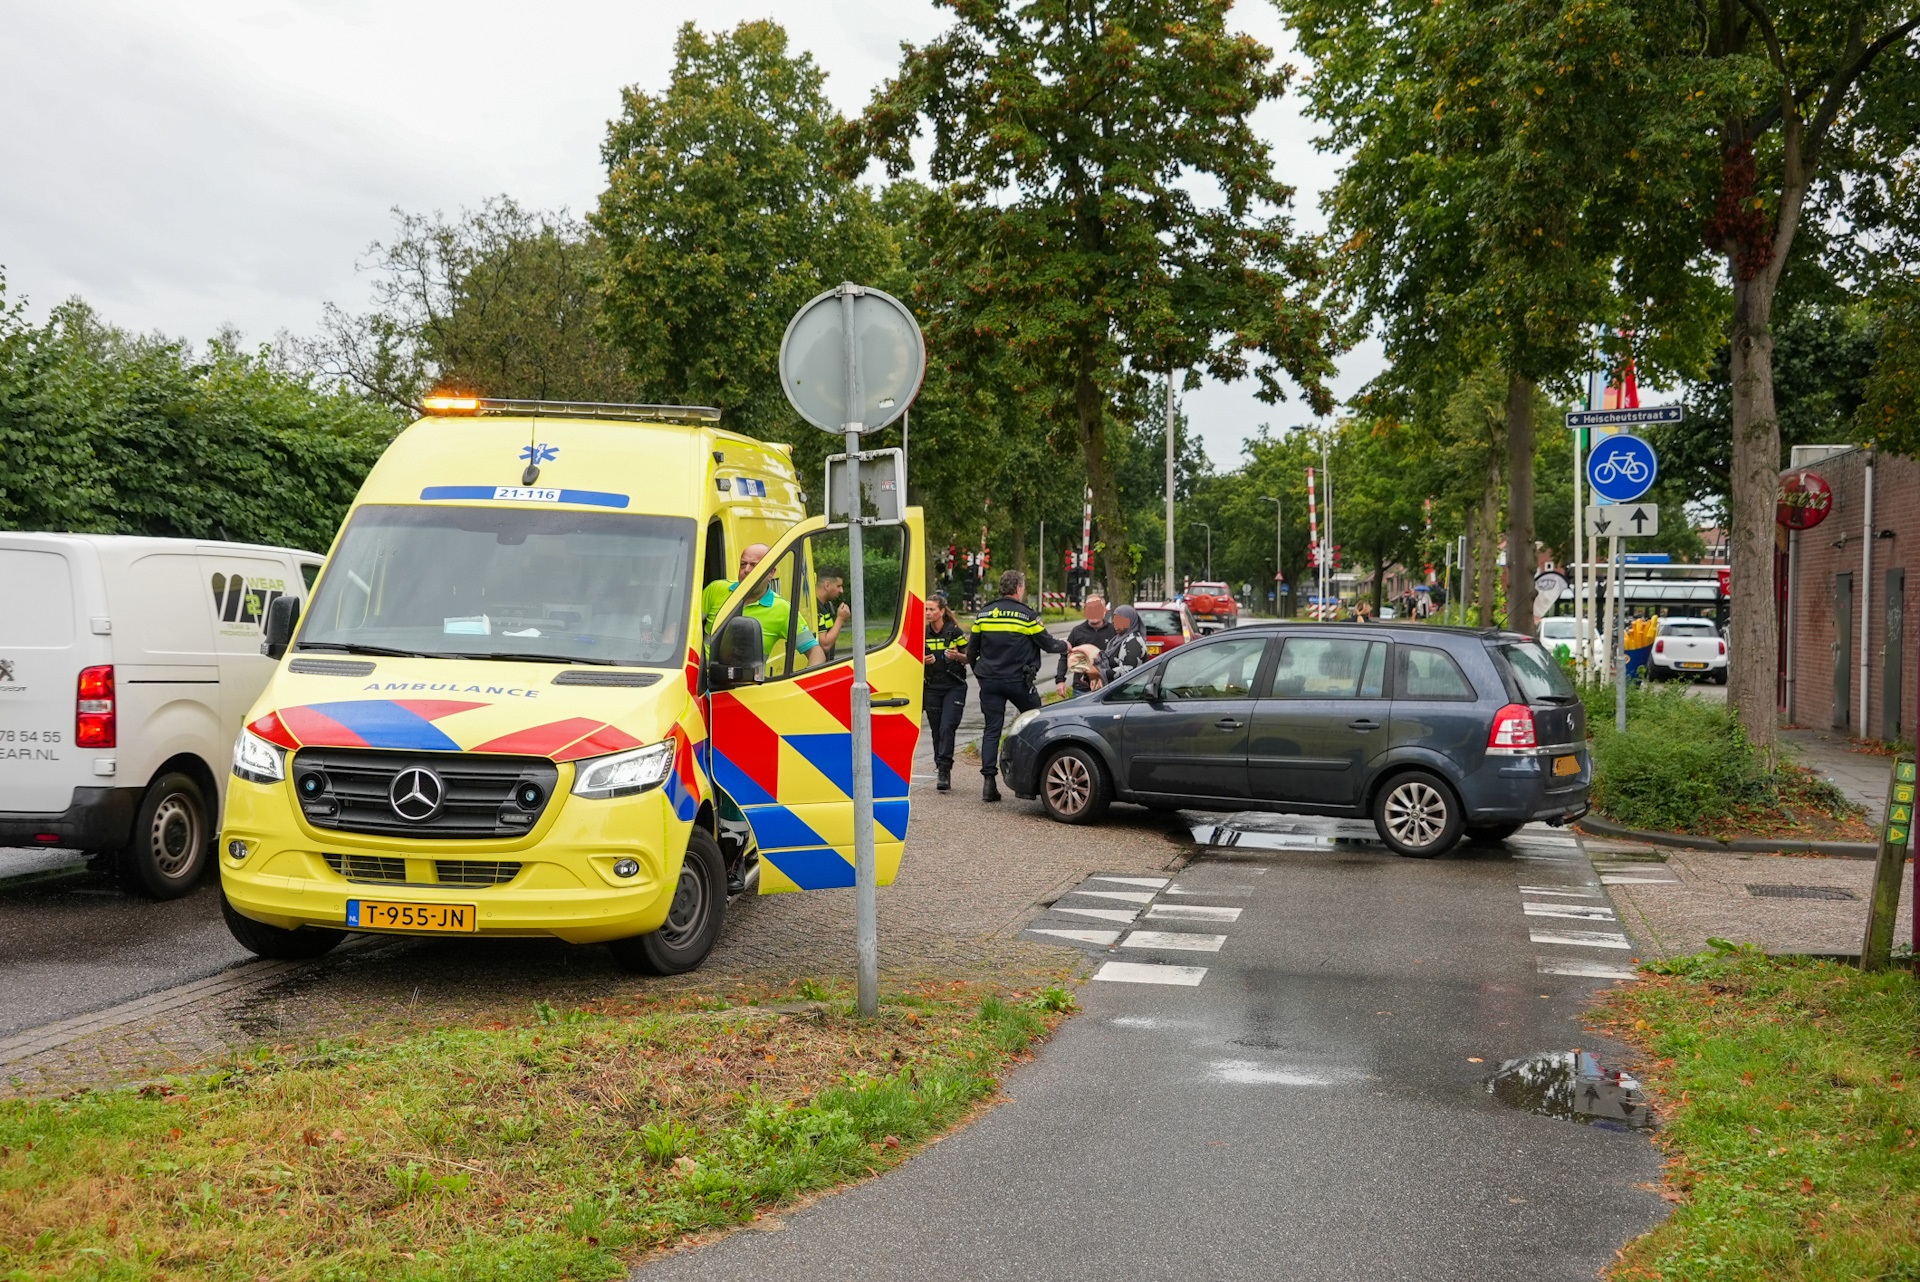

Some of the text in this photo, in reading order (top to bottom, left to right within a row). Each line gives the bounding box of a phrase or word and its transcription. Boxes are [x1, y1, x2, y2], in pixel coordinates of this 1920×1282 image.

[1583, 410, 1663, 424] Heischeutstraat
[499, 489, 555, 499] 21-116
[246, 577, 286, 590] WEAR
[363, 683, 540, 698] AMBULANCE
[19, 730, 38, 743] 54
[42, 731, 62, 743] 55
[366, 905, 465, 928] T-955-JN
